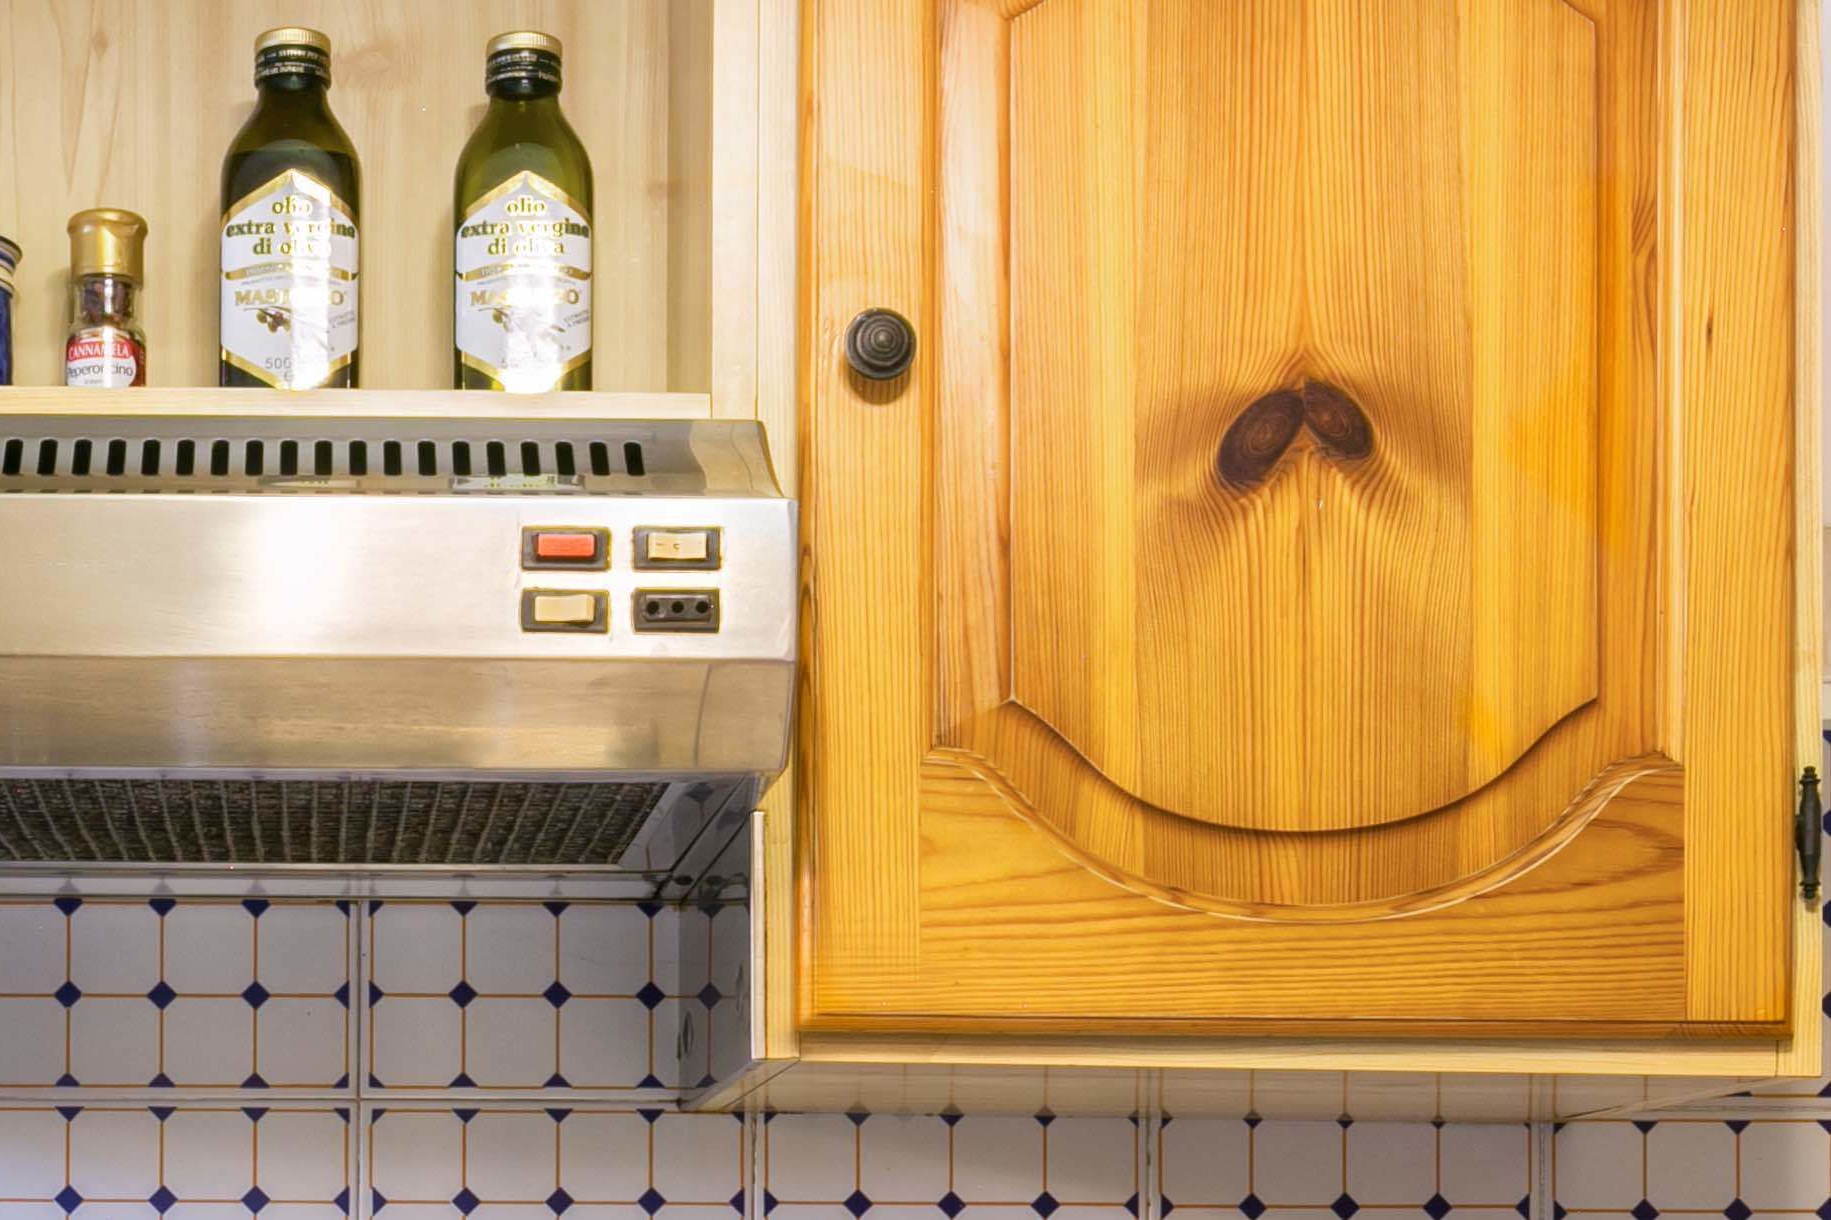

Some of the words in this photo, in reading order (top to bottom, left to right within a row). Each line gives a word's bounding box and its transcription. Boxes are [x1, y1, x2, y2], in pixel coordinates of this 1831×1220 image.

[506, 197, 545, 213] olio
[226, 219, 274, 238] extra
[461, 220, 510, 238] extra
[252, 237, 272, 255] di
[487, 237, 507, 255] di
[69, 343, 131, 360] CANNAELA
